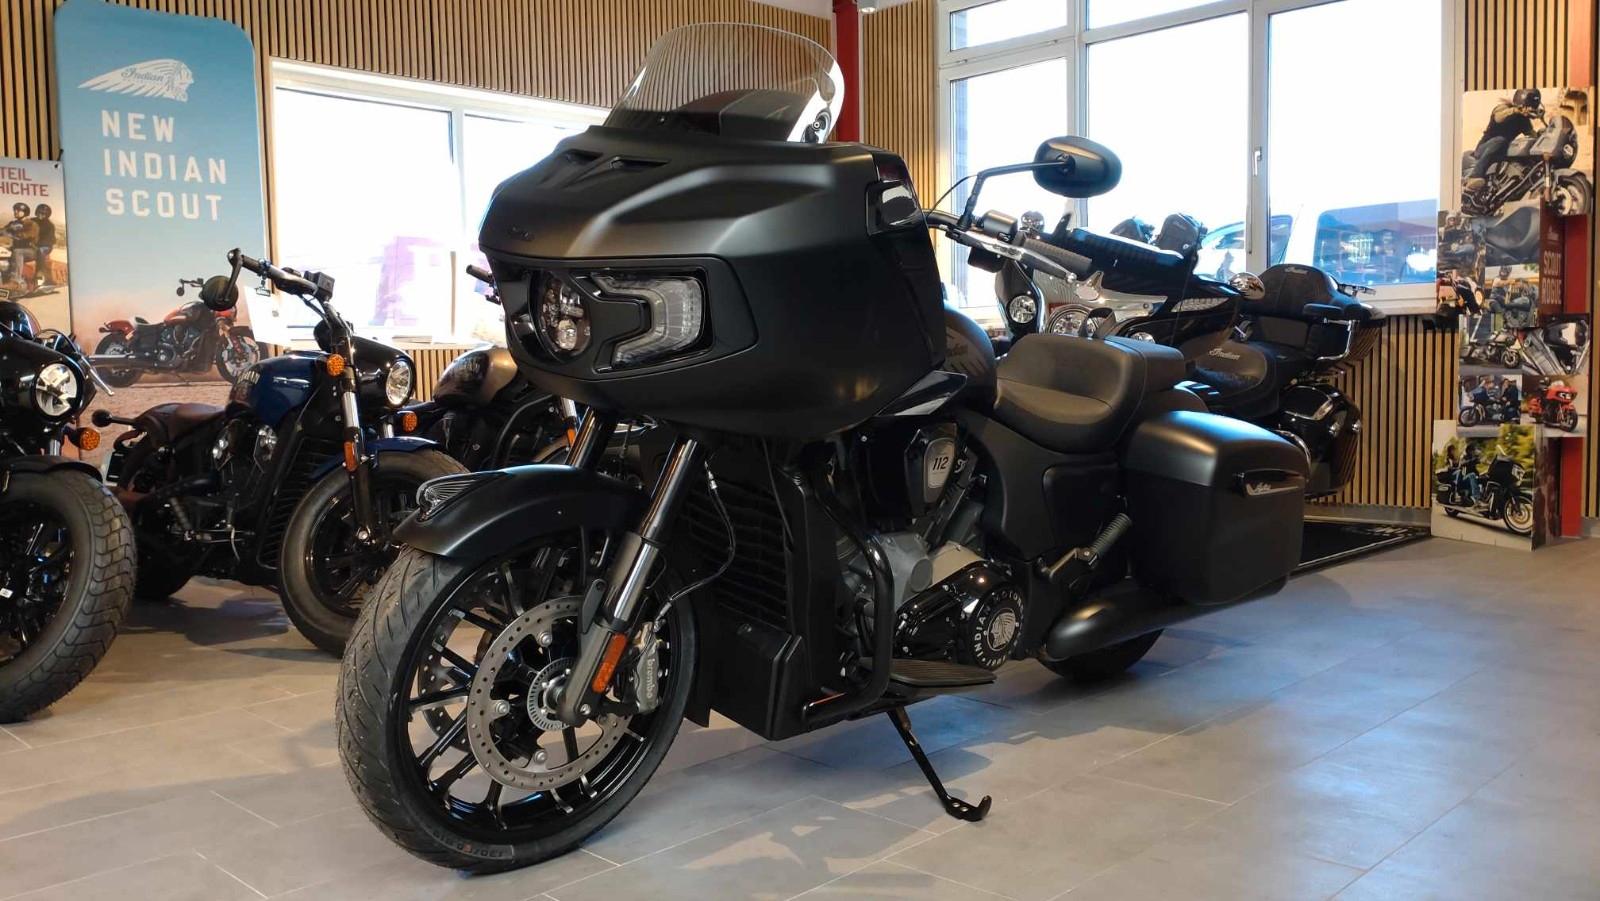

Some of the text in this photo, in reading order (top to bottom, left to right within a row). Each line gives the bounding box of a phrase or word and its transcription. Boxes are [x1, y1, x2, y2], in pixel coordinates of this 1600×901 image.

[102, 109, 175, 143] NEW
[0, 167, 32, 181] TEIL
[103, 149, 227, 184] INDIAN
[105, 188, 223, 221] SCOUT
[932, 456, 949, 471] 112
[646, 658, 656, 699] brembo
